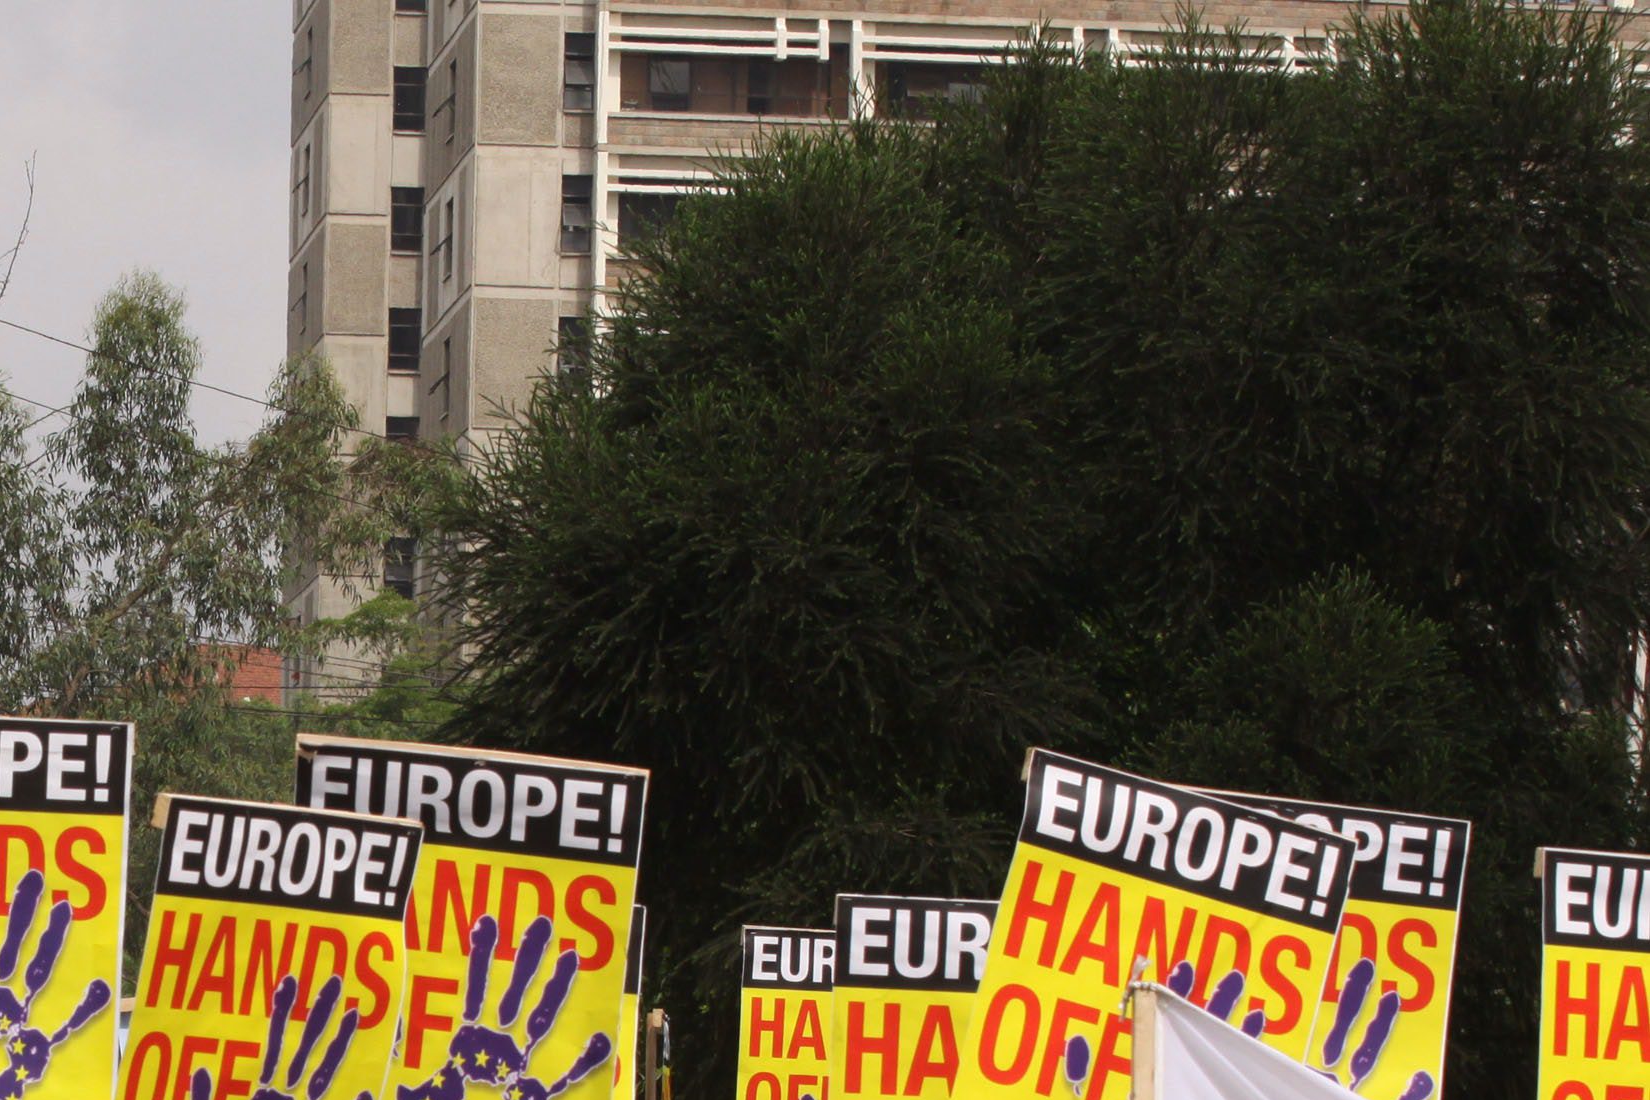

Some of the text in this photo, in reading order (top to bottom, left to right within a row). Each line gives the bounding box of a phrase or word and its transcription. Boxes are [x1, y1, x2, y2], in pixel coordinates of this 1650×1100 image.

[167, 809, 408, 907] EUROPE!
[310, 754, 628, 853] EUROPE!
[1037, 765, 1340, 918] EUROPE!
[144, 910, 395, 1030] HANDS
[404, 859, 617, 972] NDS
[1003, 861, 1312, 1036] HANDS
